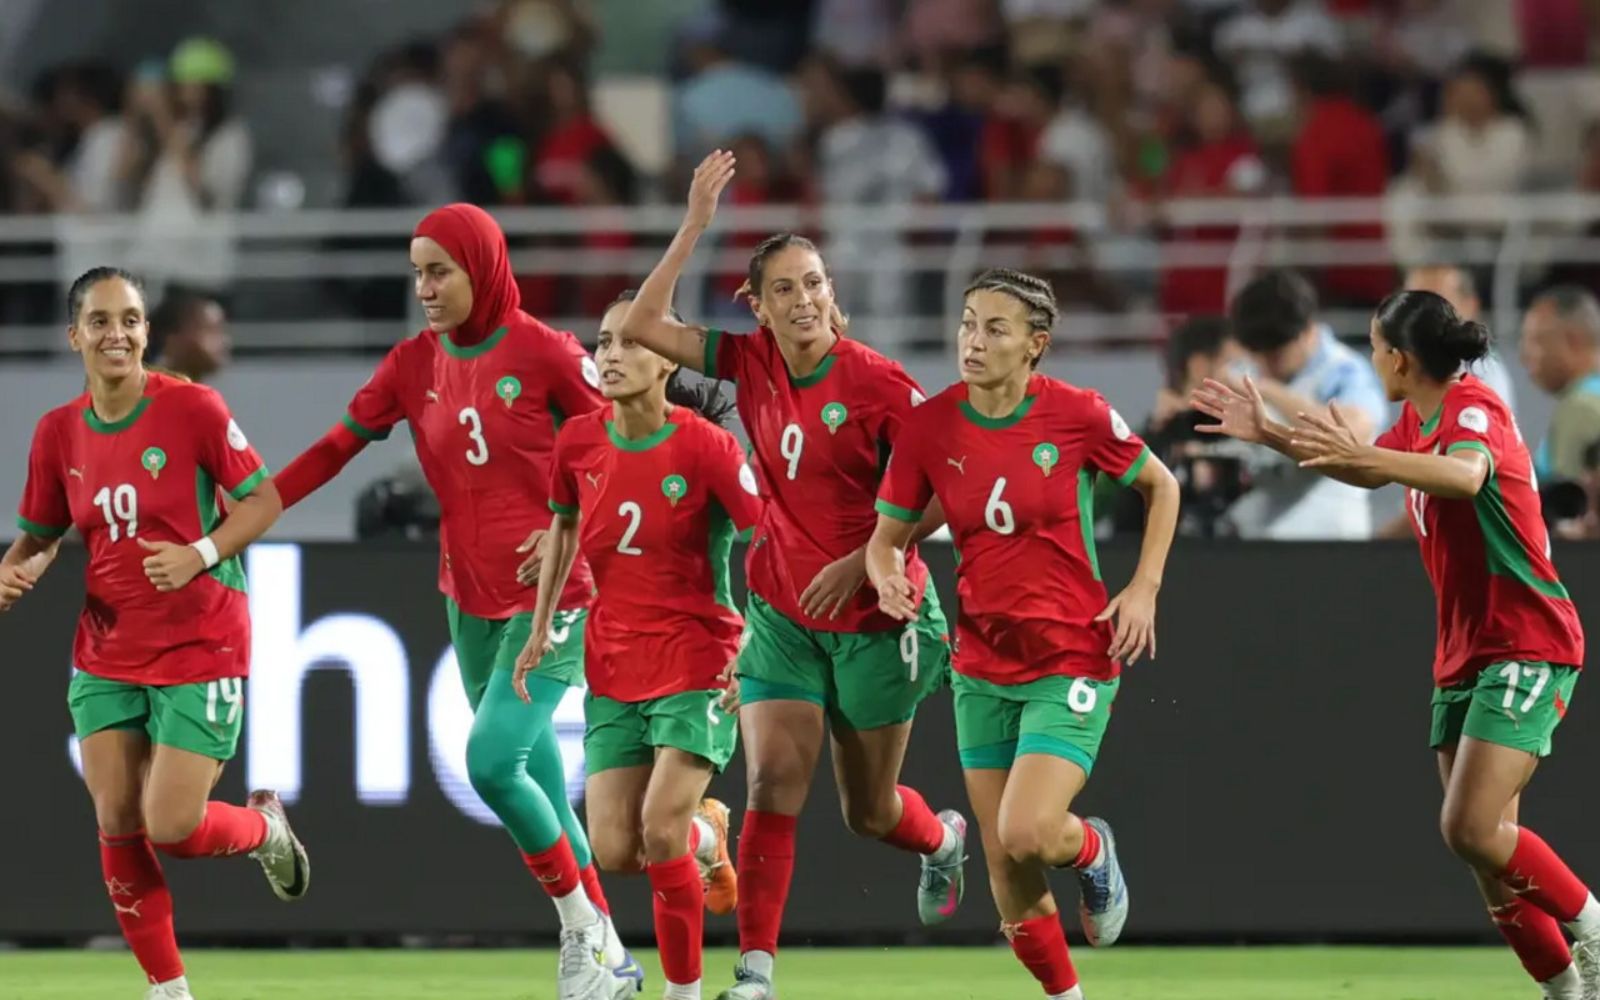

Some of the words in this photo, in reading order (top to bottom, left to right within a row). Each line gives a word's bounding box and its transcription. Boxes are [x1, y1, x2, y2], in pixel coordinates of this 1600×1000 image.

[458, 406, 489, 465] 3
[780, 423, 804, 480] 9
[93, 484, 138, 542] 19
[617, 501, 642, 555] 2
[984, 476, 1015, 535] 6
[900, 627, 919, 682] 9
[206, 676, 242, 725] 19
[1067, 676, 1097, 713] 6
[1499, 661, 1551, 713] 17
